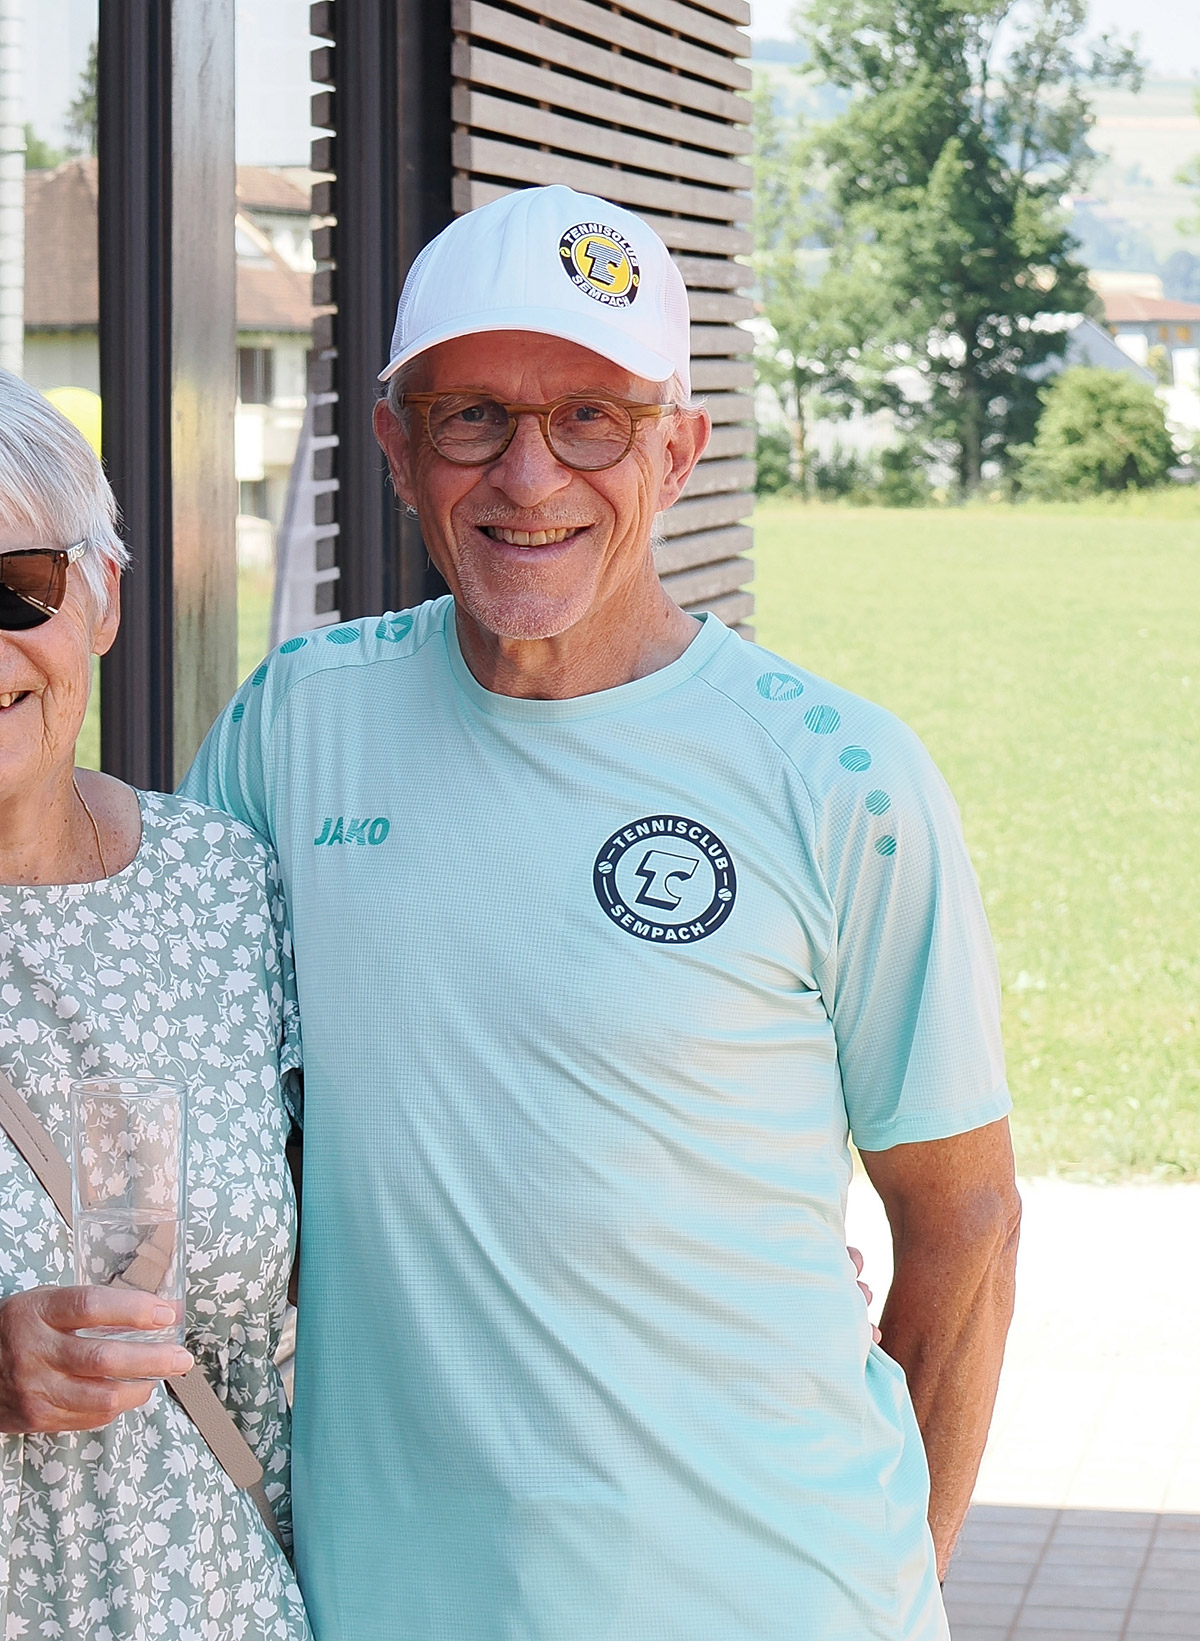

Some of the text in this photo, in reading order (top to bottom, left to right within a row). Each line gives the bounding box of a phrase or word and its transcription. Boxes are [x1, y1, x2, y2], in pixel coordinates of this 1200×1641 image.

[572, 274, 630, 307] SEMPACH
[314, 816, 391, 846] JAKO
[612, 819, 729, 870] TENNISCLUB
[610, 904, 706, 941] SEMPACH
